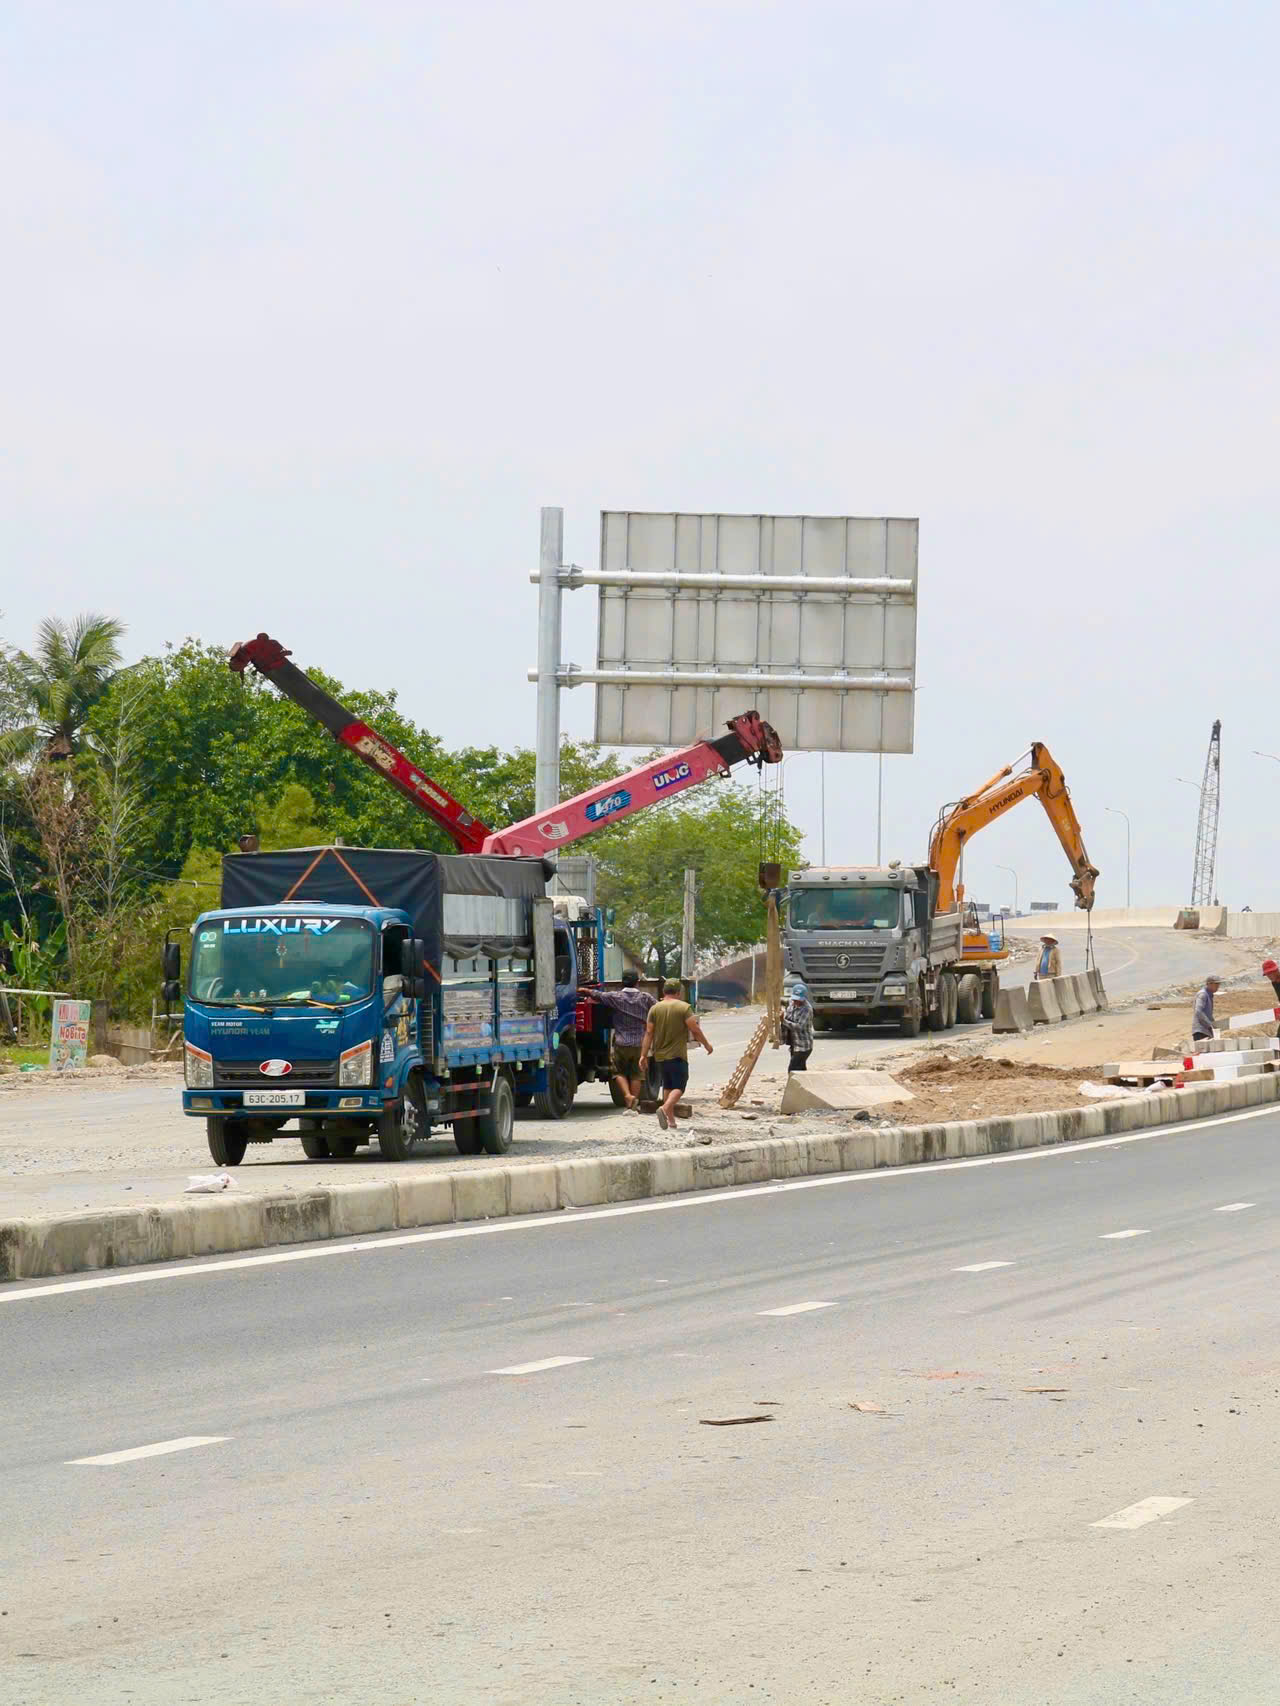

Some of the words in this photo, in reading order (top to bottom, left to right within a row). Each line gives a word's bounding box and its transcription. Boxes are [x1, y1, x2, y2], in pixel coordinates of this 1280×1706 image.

[653, 762, 690, 788] UNIC
[989, 788, 1024, 814] HYUNDAI
[223, 919, 341, 936] LUXURY
[248, 1094, 300, 1104] 63C-205.17
